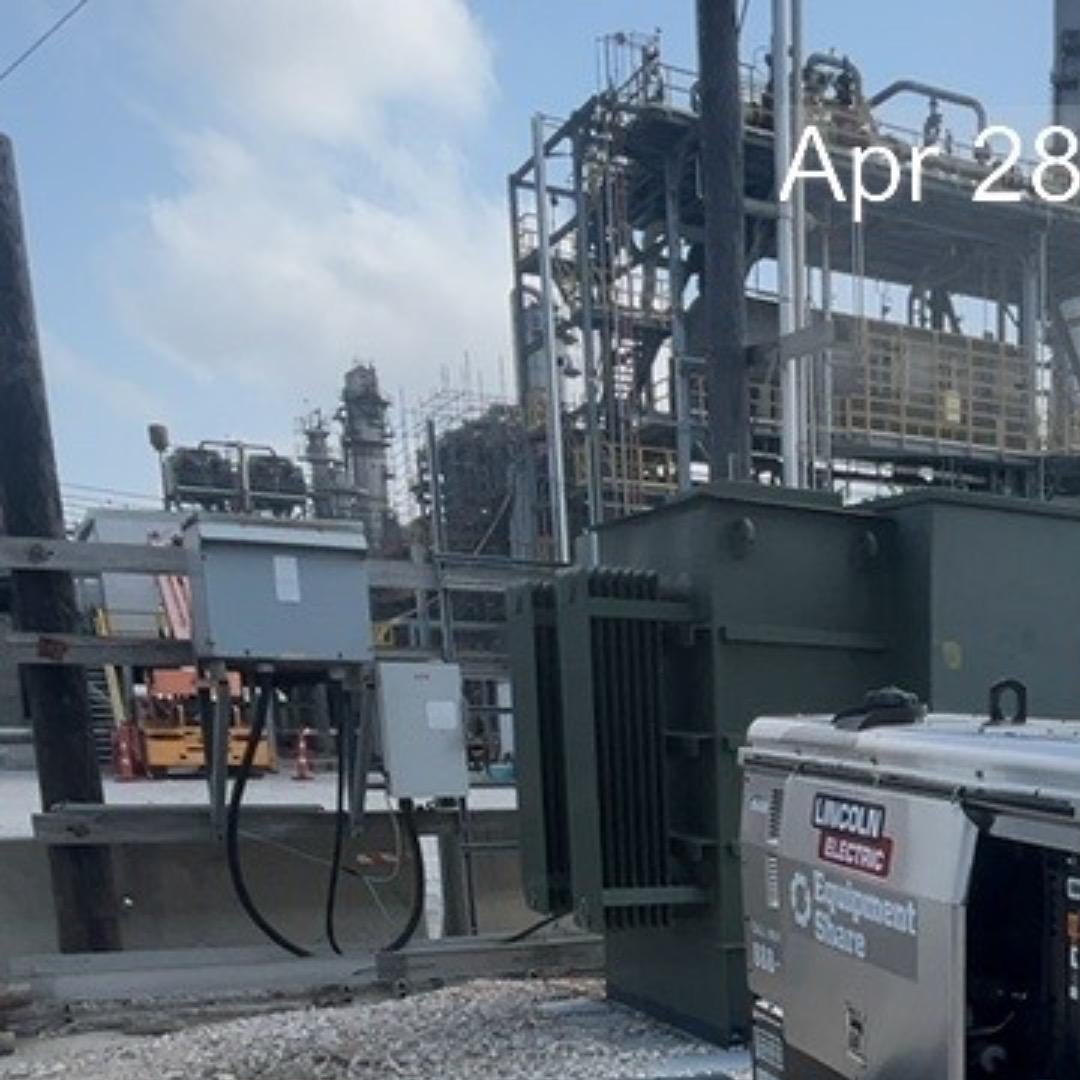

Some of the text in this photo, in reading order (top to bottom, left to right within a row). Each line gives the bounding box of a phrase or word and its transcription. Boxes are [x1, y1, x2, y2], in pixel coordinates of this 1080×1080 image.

[814, 797, 883, 839] LINCOLN
[823, 835, 886, 872] ELECTRIC
[812, 869, 917, 936] Equipment
[814, 909, 866, 960] Share
